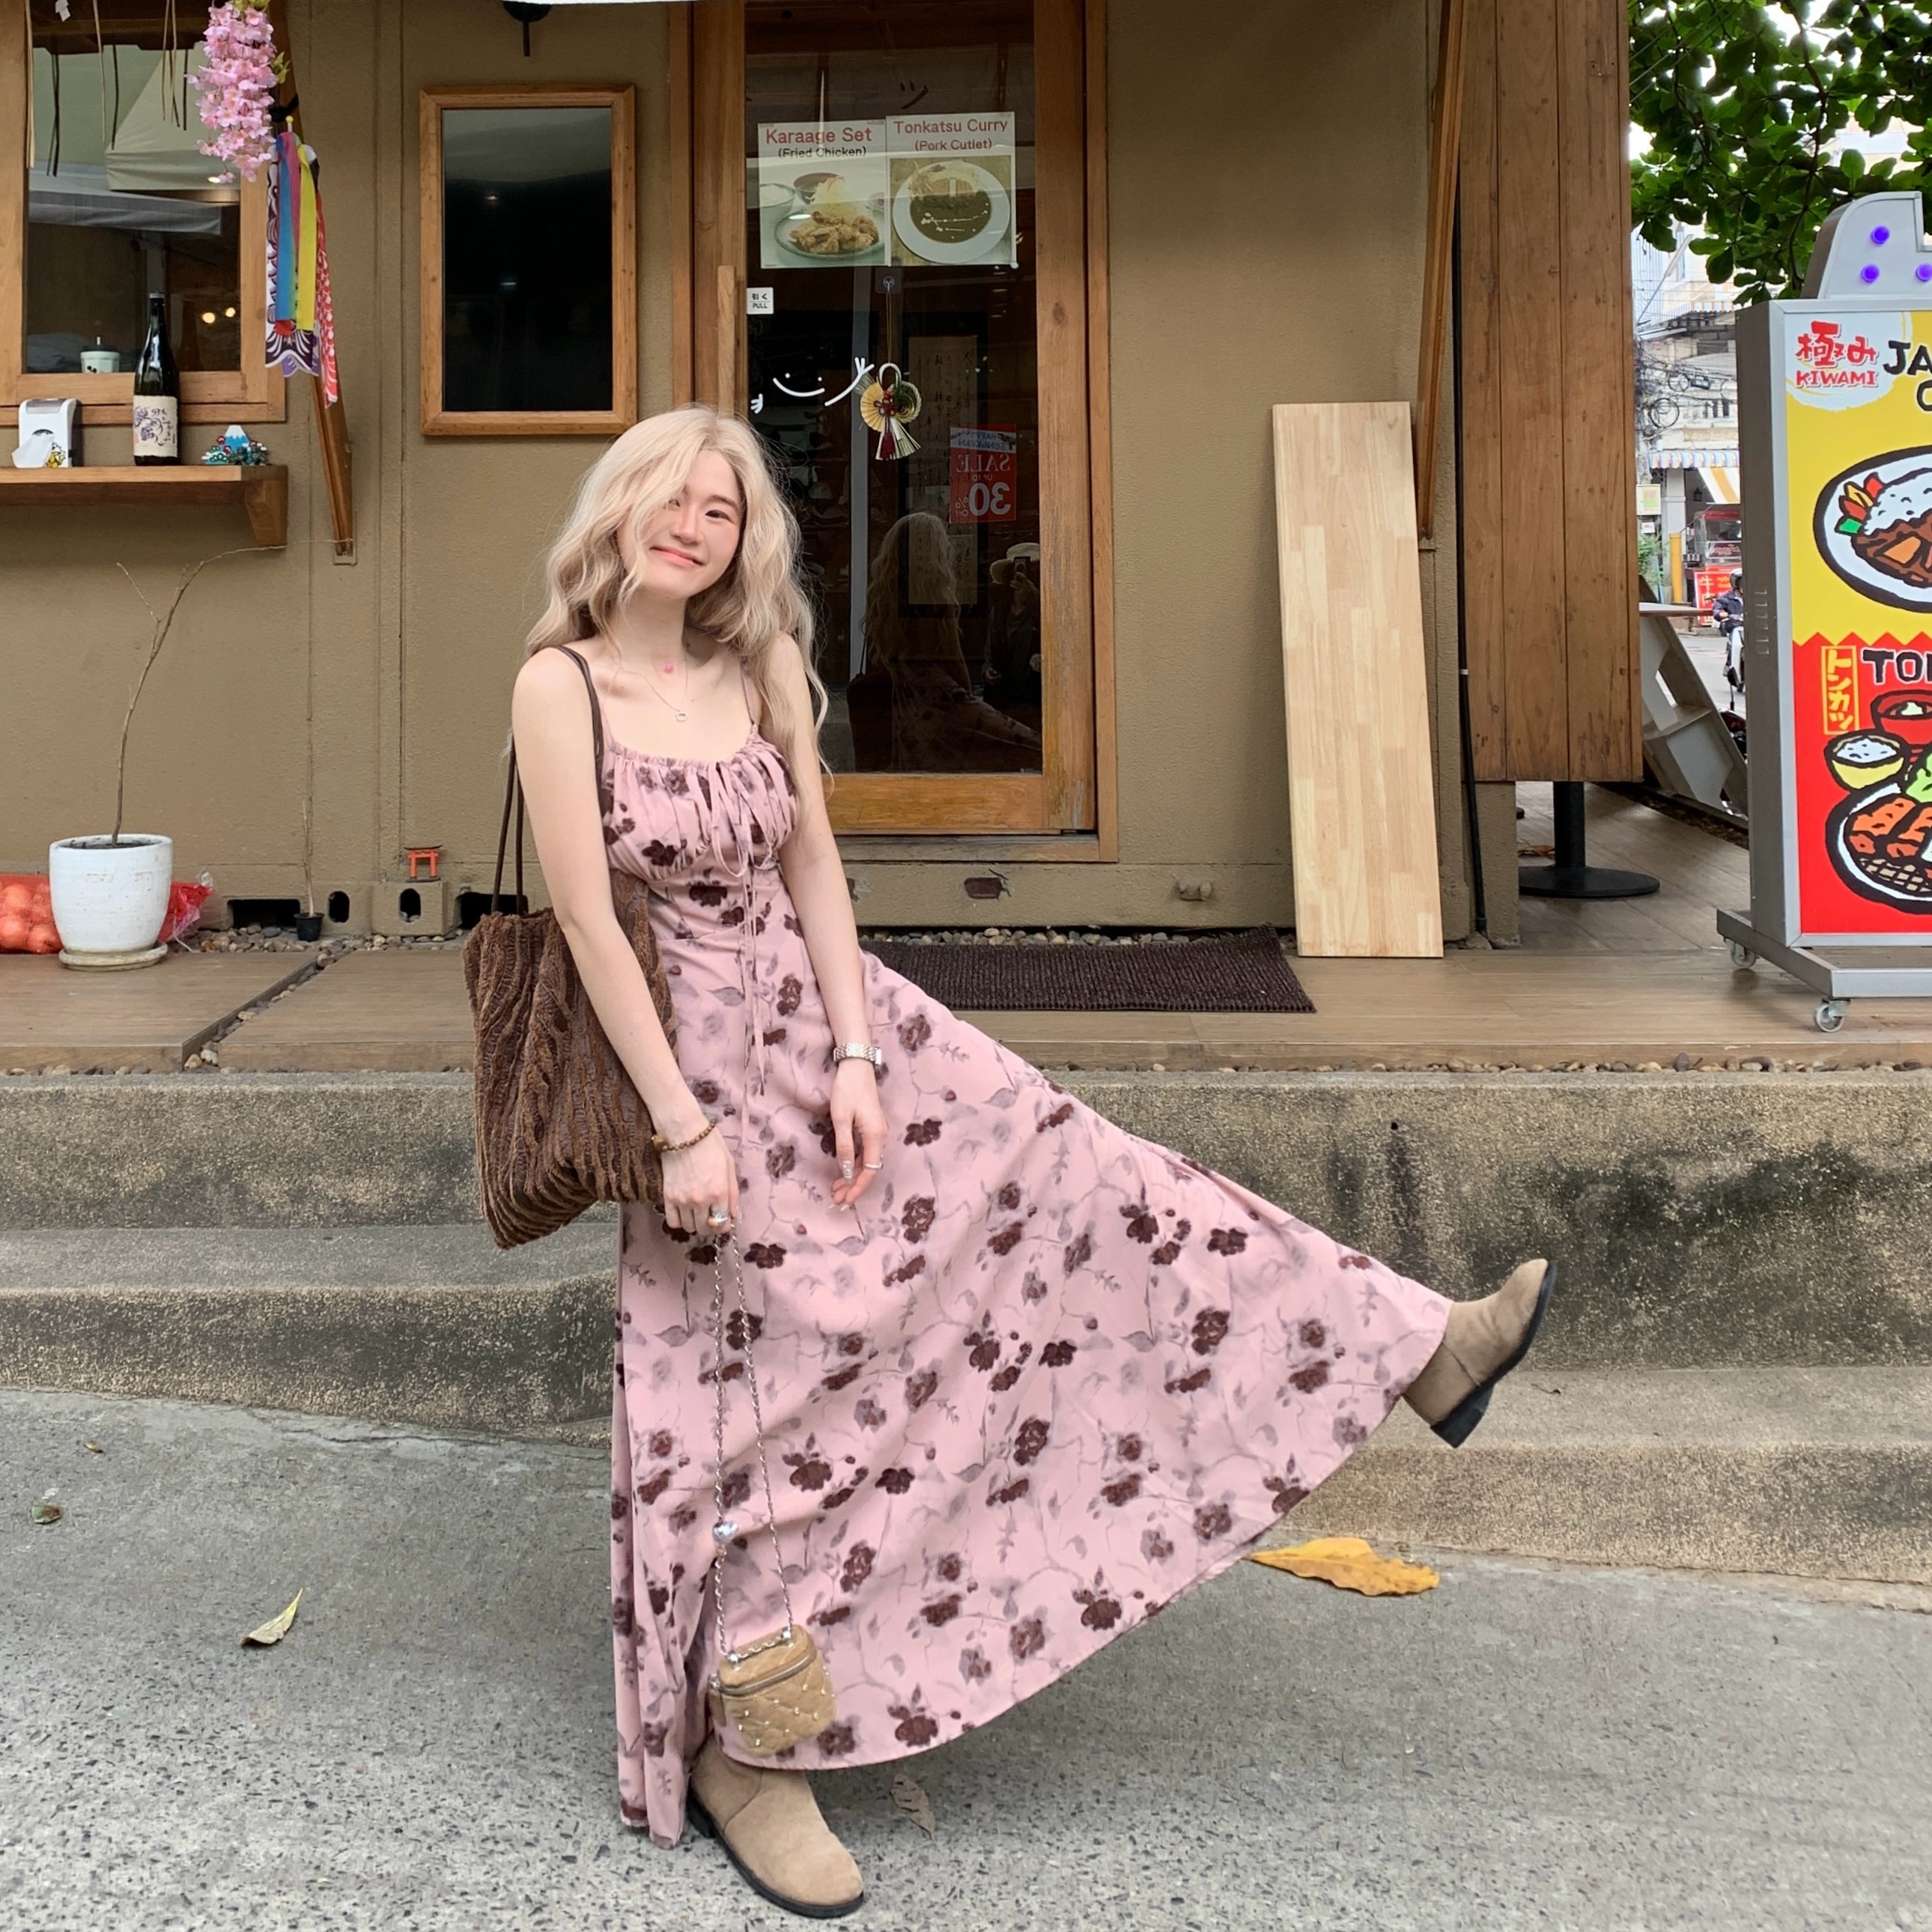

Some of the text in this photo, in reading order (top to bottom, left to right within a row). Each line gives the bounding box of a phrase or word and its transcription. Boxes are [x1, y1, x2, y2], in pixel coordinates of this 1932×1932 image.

[893, 118, 1008, 134] Tonkatsu Curry
[766, 127, 872, 145] Karaage Set
[915, 137, 992, 151] (Pork Cutlet)
[778, 145, 866, 159] (Fried Chicken)
[1795, 321, 1877, 366] 極み
[1796, 369, 1878, 386] KIWAMI
[1862, 648, 1932, 683] TO
[1827, 648, 1854, 730] トンカツ
